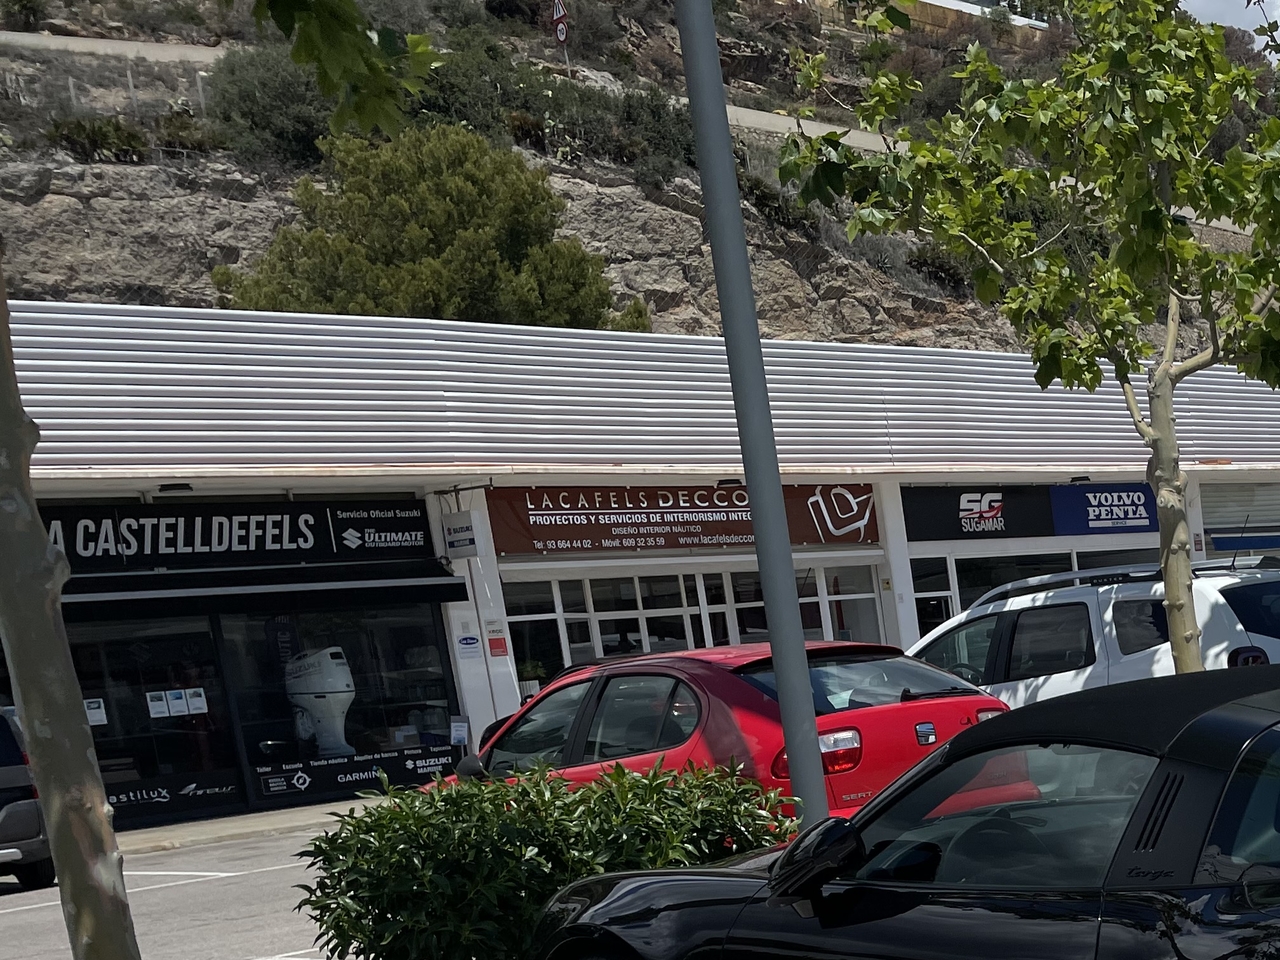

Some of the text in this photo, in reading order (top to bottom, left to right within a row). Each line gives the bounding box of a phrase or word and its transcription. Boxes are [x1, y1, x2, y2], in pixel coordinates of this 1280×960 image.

[526, 491, 648, 509] LACAFELS
[959, 492, 1004, 518] SG
[1086, 492, 1146, 506] VOLVO
[337, 509, 421, 518] Servicio Oficial Suzuki
[529, 515, 587, 525] PROYECTOS
[588, 514, 596, 523] Y
[599, 513, 647, 523] SERVICIOS
[650, 513, 662, 522] DE
[664, 512, 727, 522] INTERIORISMO
[1087, 505, 1149, 520] PENTA
[612, 525, 638, 535] DISEÑO
[639, 526, 671, 534] INTERIOR
[961, 517, 1006, 532] SUGAMAR
[75, 513, 315, 557] CASTELLDEFELS
[365, 531, 424, 542] ULTIMATE
[547, 541, 556, 549] 93
[557, 540, 571, 548] 664
[571, 540, 581, 548] 44
[582, 540, 592, 548] 02
[622, 538, 636, 547] 609
[637, 538, 646, 546] 32
[646, 538, 655, 546] 35
[656, 537, 665, 546] 59
[415, 756, 452, 767] SUZUKI
[337, 770, 380, 783] GARMIN
[842, 791, 873, 801] SEAT
